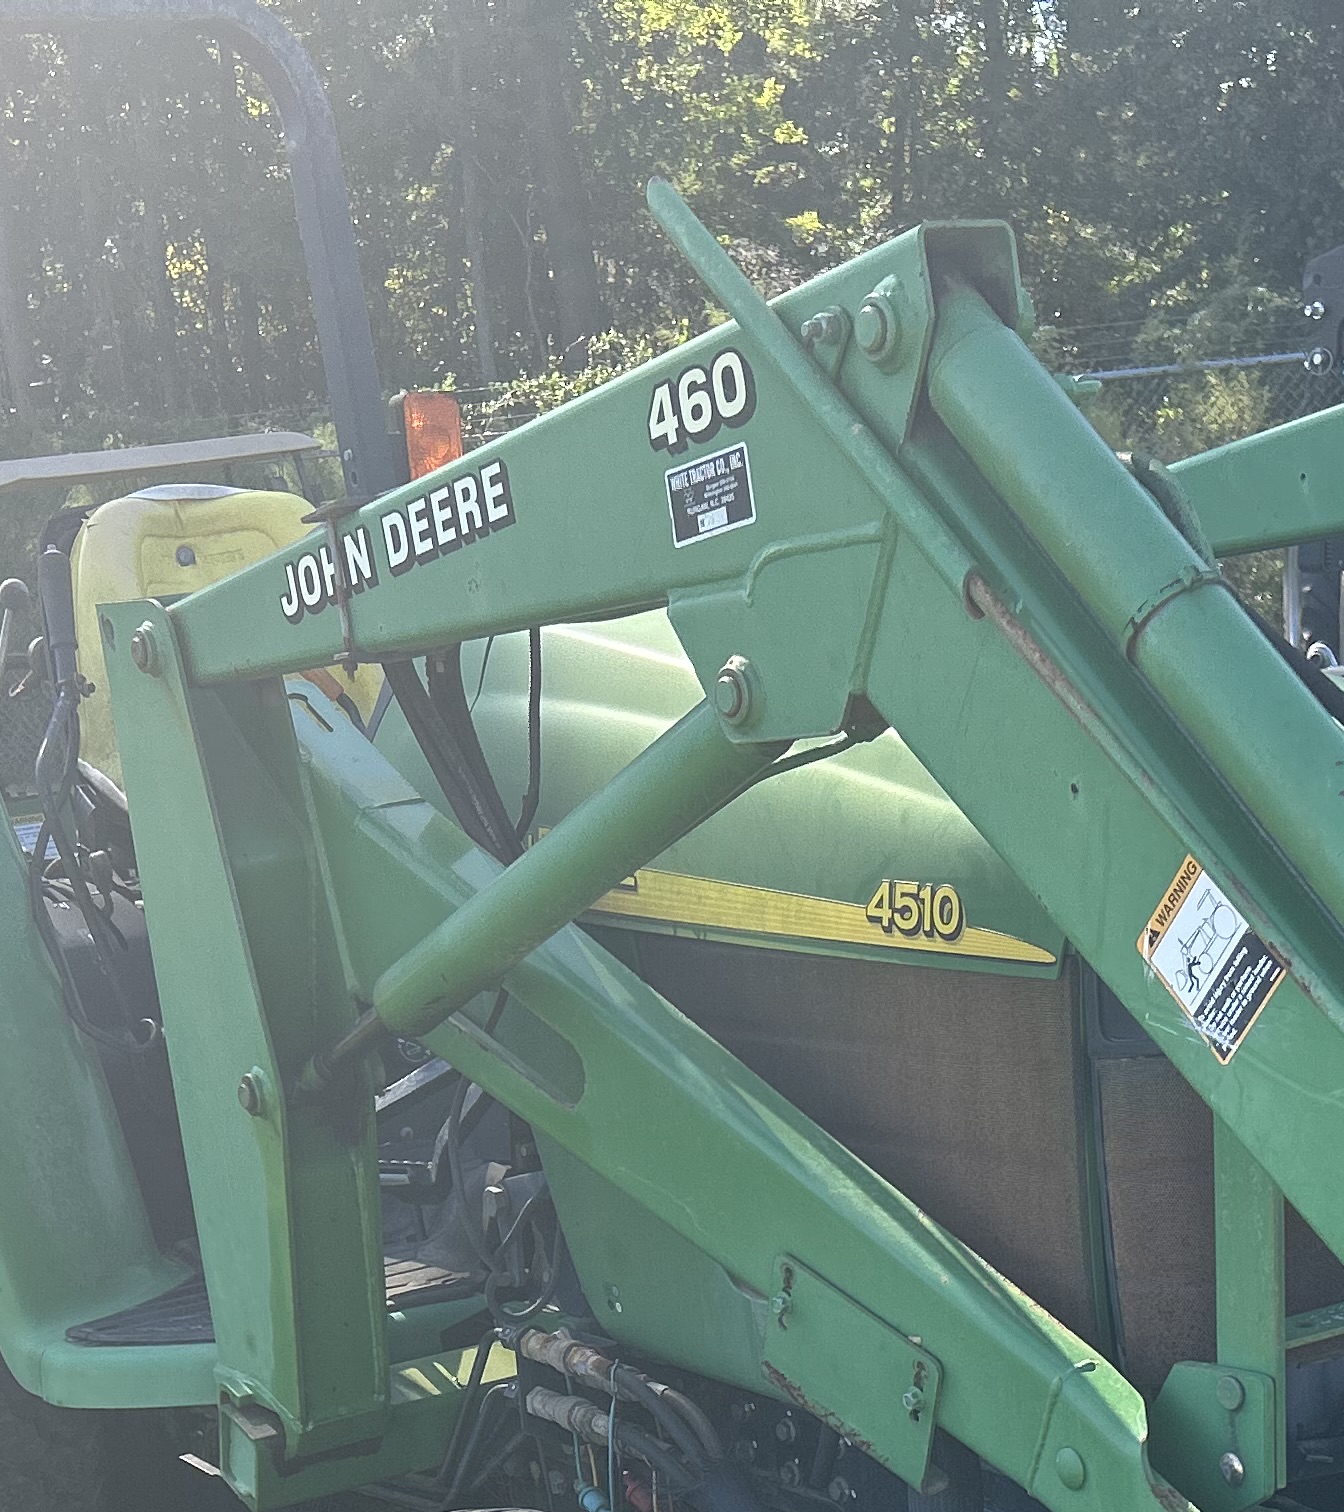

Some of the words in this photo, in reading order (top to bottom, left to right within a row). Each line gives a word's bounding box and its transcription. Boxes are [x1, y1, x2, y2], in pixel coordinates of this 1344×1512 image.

[649, 350, 749, 449] 460
[689, 461, 716, 485] TRACTOR
[380, 460, 511, 570] DEERE
[864, 879, 963, 938] 4510
[1155, 860, 1198, 927] WARNING
